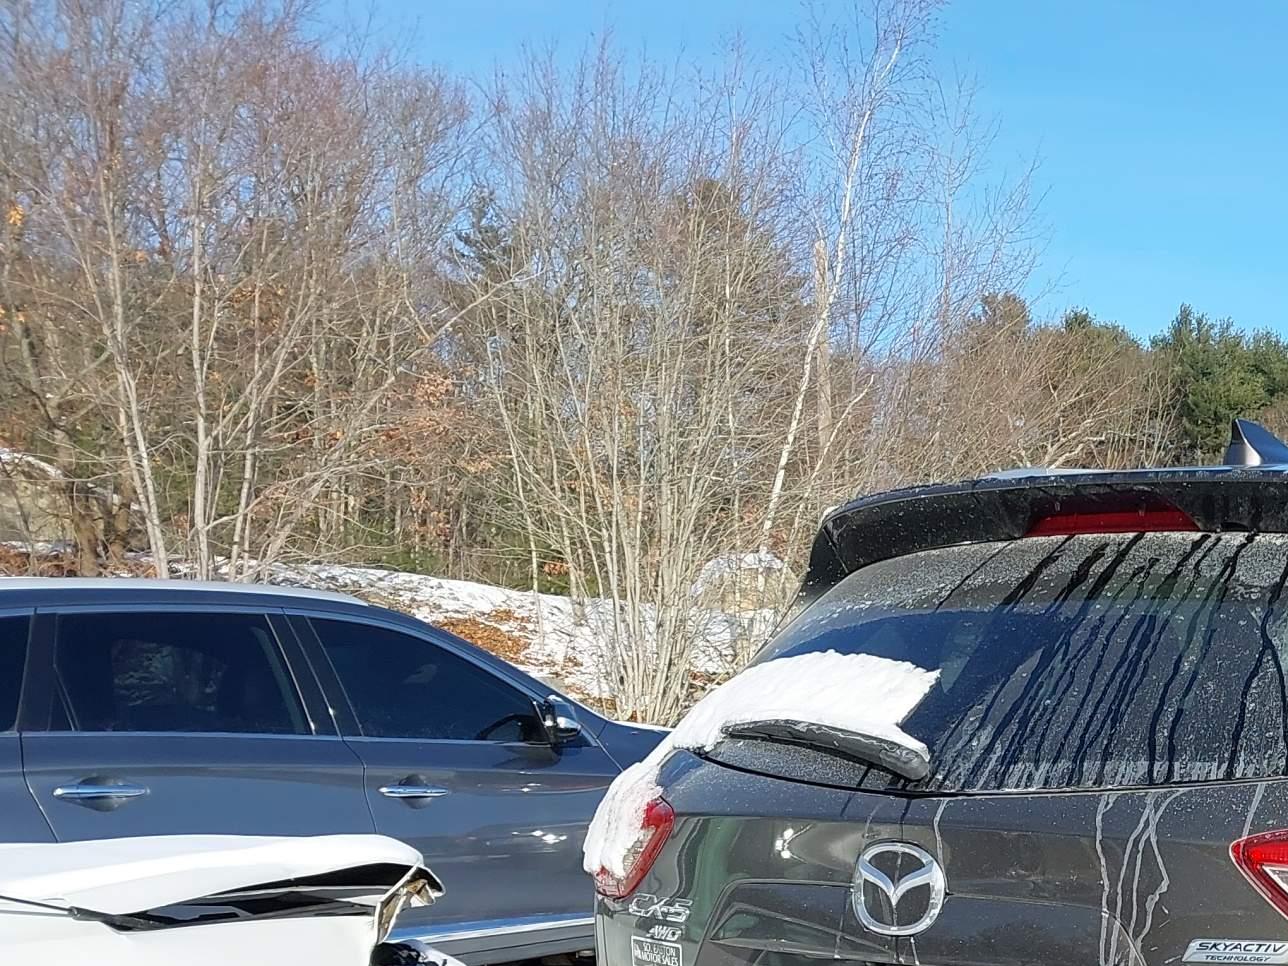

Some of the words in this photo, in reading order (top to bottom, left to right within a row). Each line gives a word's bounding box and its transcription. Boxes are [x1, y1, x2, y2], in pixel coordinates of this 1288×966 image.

[629, 892, 693, 922] CX-5
[645, 925, 682, 941] AWD
[1196, 942, 1286, 953] SKYACTIV
[641, 951, 661, 964] MOTOR
[1205, 954, 1271, 962] TECHNOLOGY
